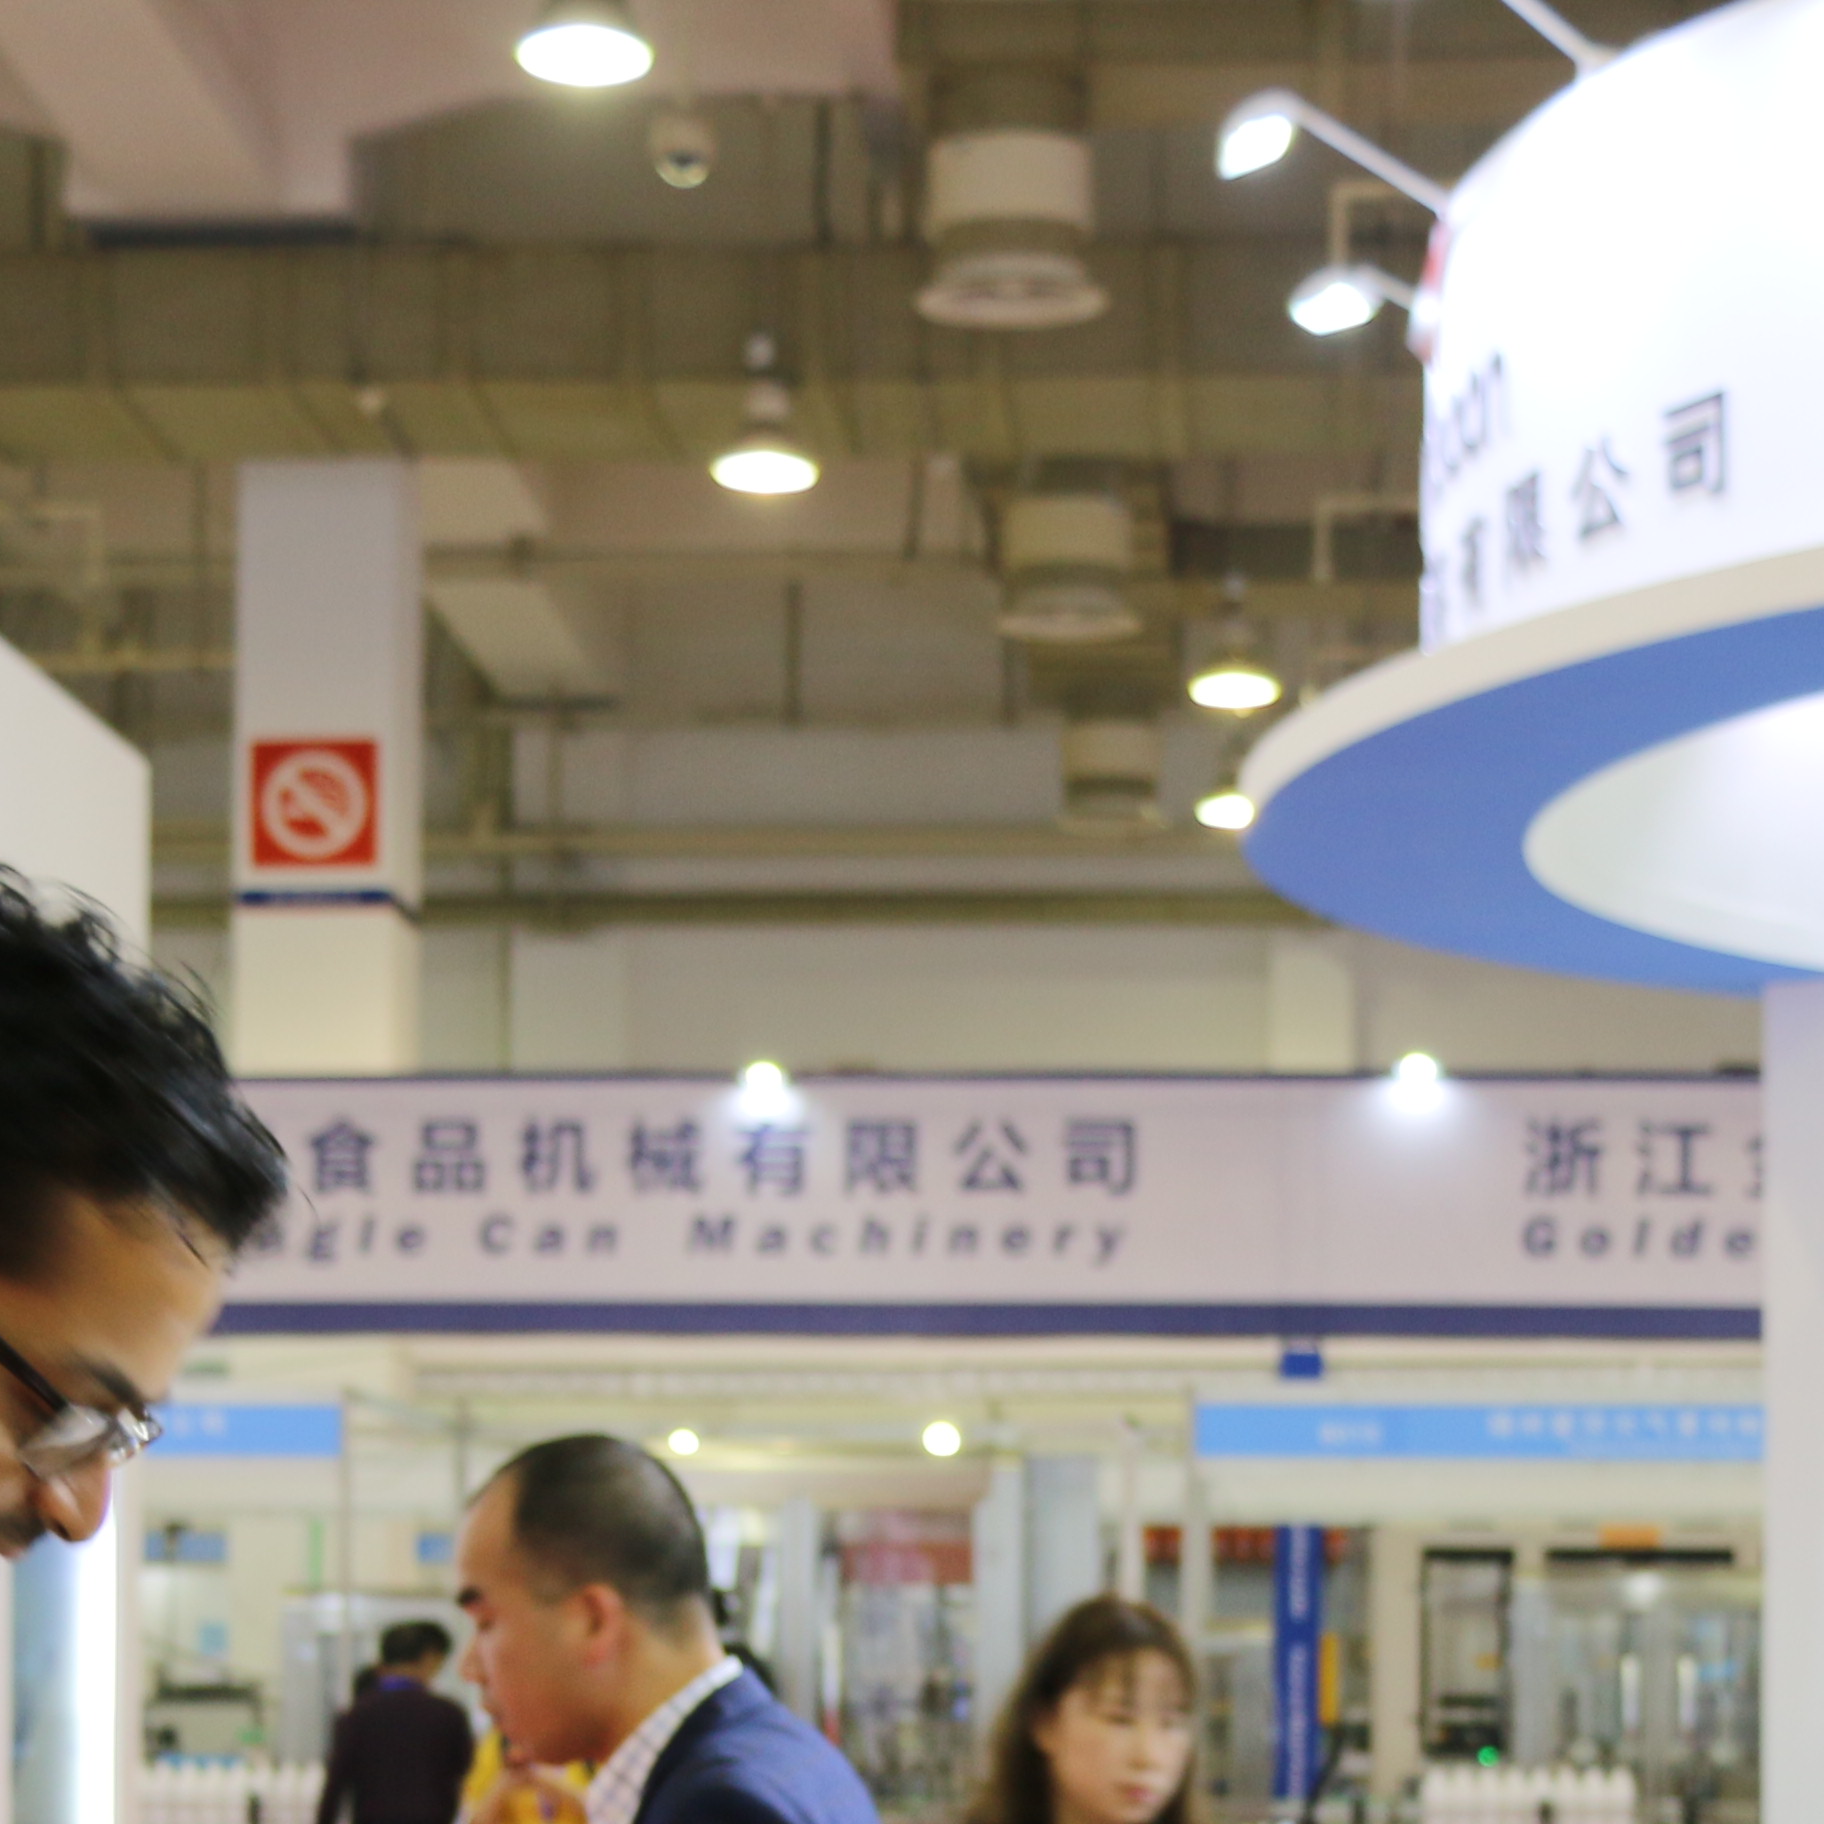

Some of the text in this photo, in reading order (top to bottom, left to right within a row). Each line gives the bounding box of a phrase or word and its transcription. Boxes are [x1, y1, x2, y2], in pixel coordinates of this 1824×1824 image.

[1420, 390, 1728, 640] 有限公司
[308, 1115, 1138, 1198] 食品机械有限公司
[479, 1213, 620, 1255] Can
[688, 1213, 1122, 1266] Machinery
[1522, 1215, 1758, 1260] Golde
